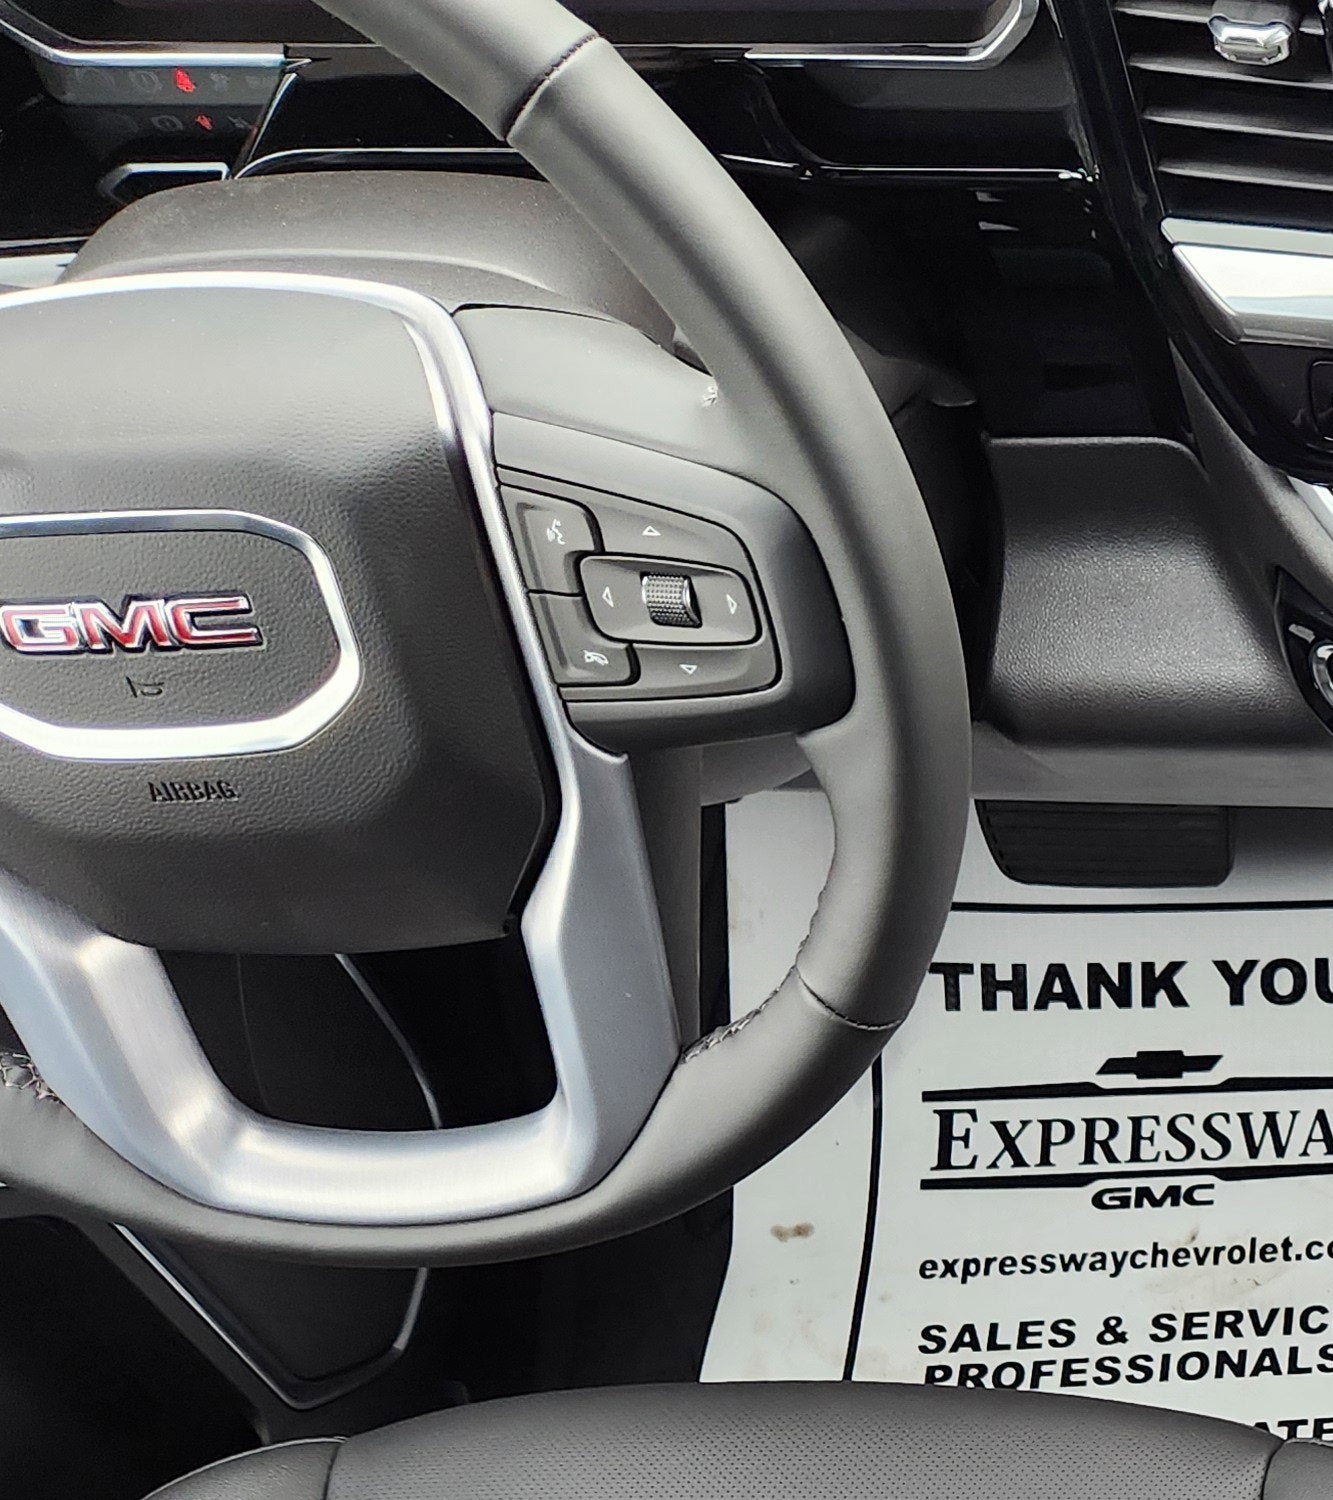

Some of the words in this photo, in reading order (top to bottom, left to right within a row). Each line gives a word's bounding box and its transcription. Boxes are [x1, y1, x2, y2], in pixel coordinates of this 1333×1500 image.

[0, 590, 265, 656] GMC
[148, 781, 237, 801] AIRBAG
[928, 959, 1190, 1012] THANK
[1091, 1183, 1216, 1211] GMC
[917, 1317, 1076, 1355] SALES
[1096, 1315, 1129, 1346] &
